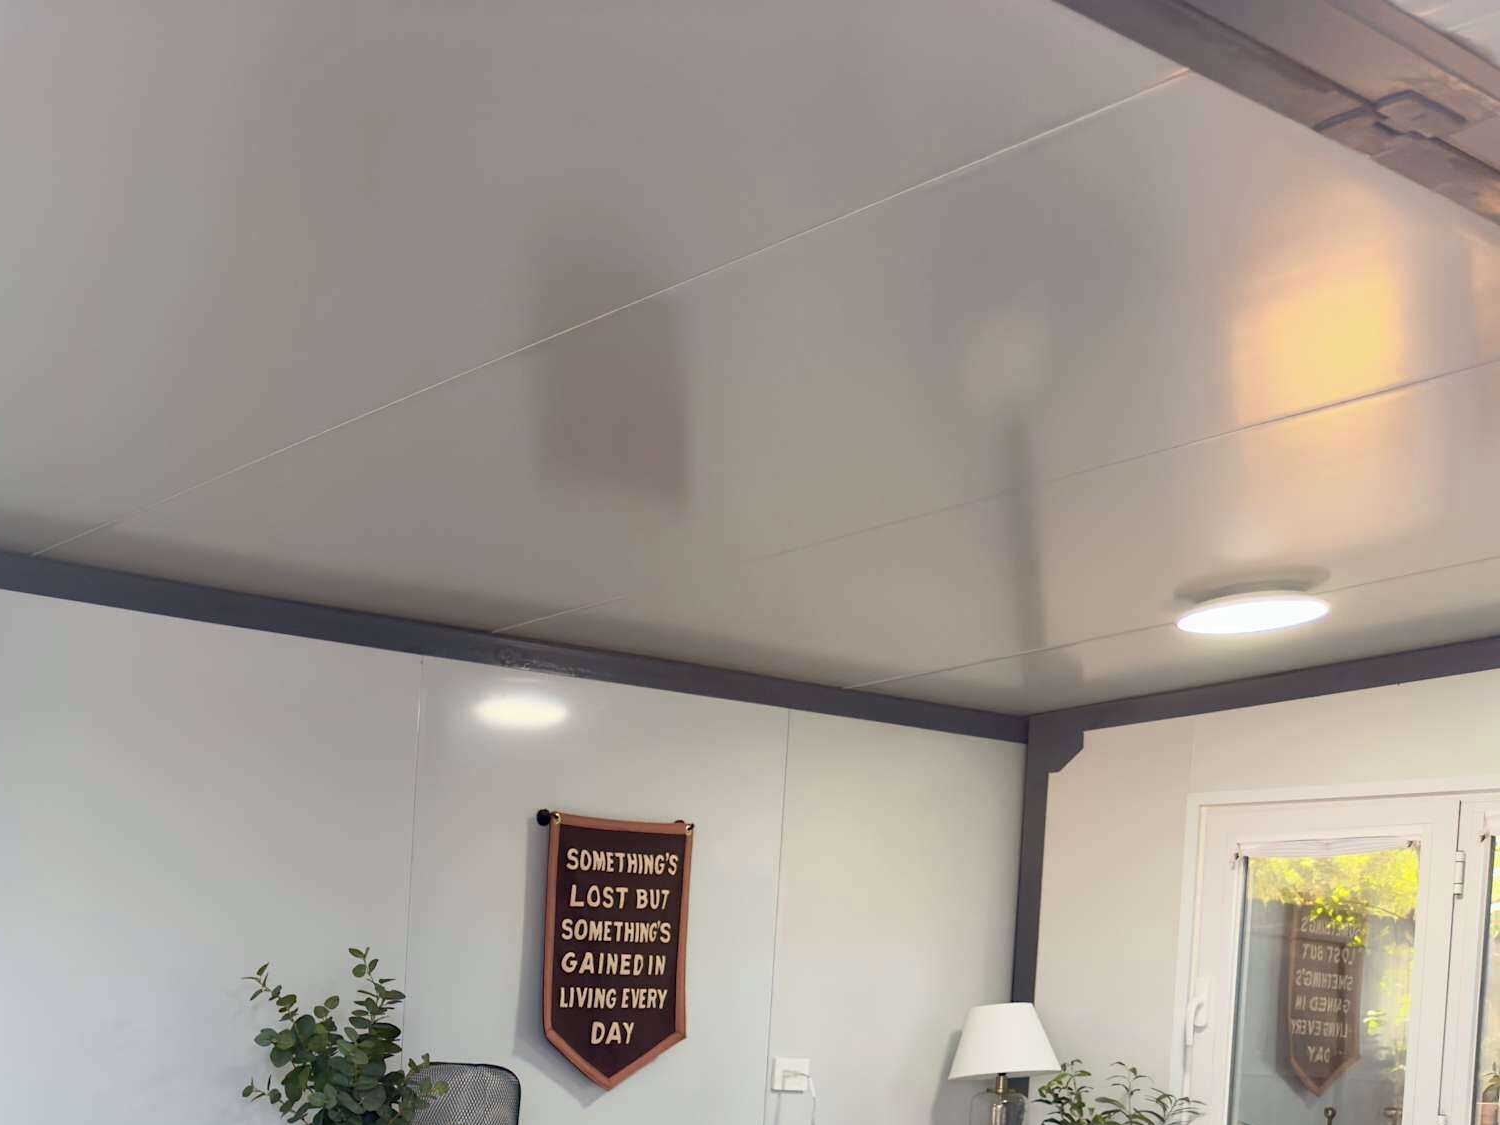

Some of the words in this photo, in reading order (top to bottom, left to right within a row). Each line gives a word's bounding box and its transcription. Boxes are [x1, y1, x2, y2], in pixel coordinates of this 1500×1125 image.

[566, 848, 678, 876] SOMETHING'S
[569, 884, 628, 909] LOST
[635, 888, 670, 910] BUT
[561, 918, 671, 944] SOMETHING'S
[561, 951, 644, 976] GAINED
[647, 954, 666, 976] IN
[559, 986, 617, 1009] LIVING
[621, 988, 668, 1009] EVERY
[590, 1021, 634, 1045] DAY
